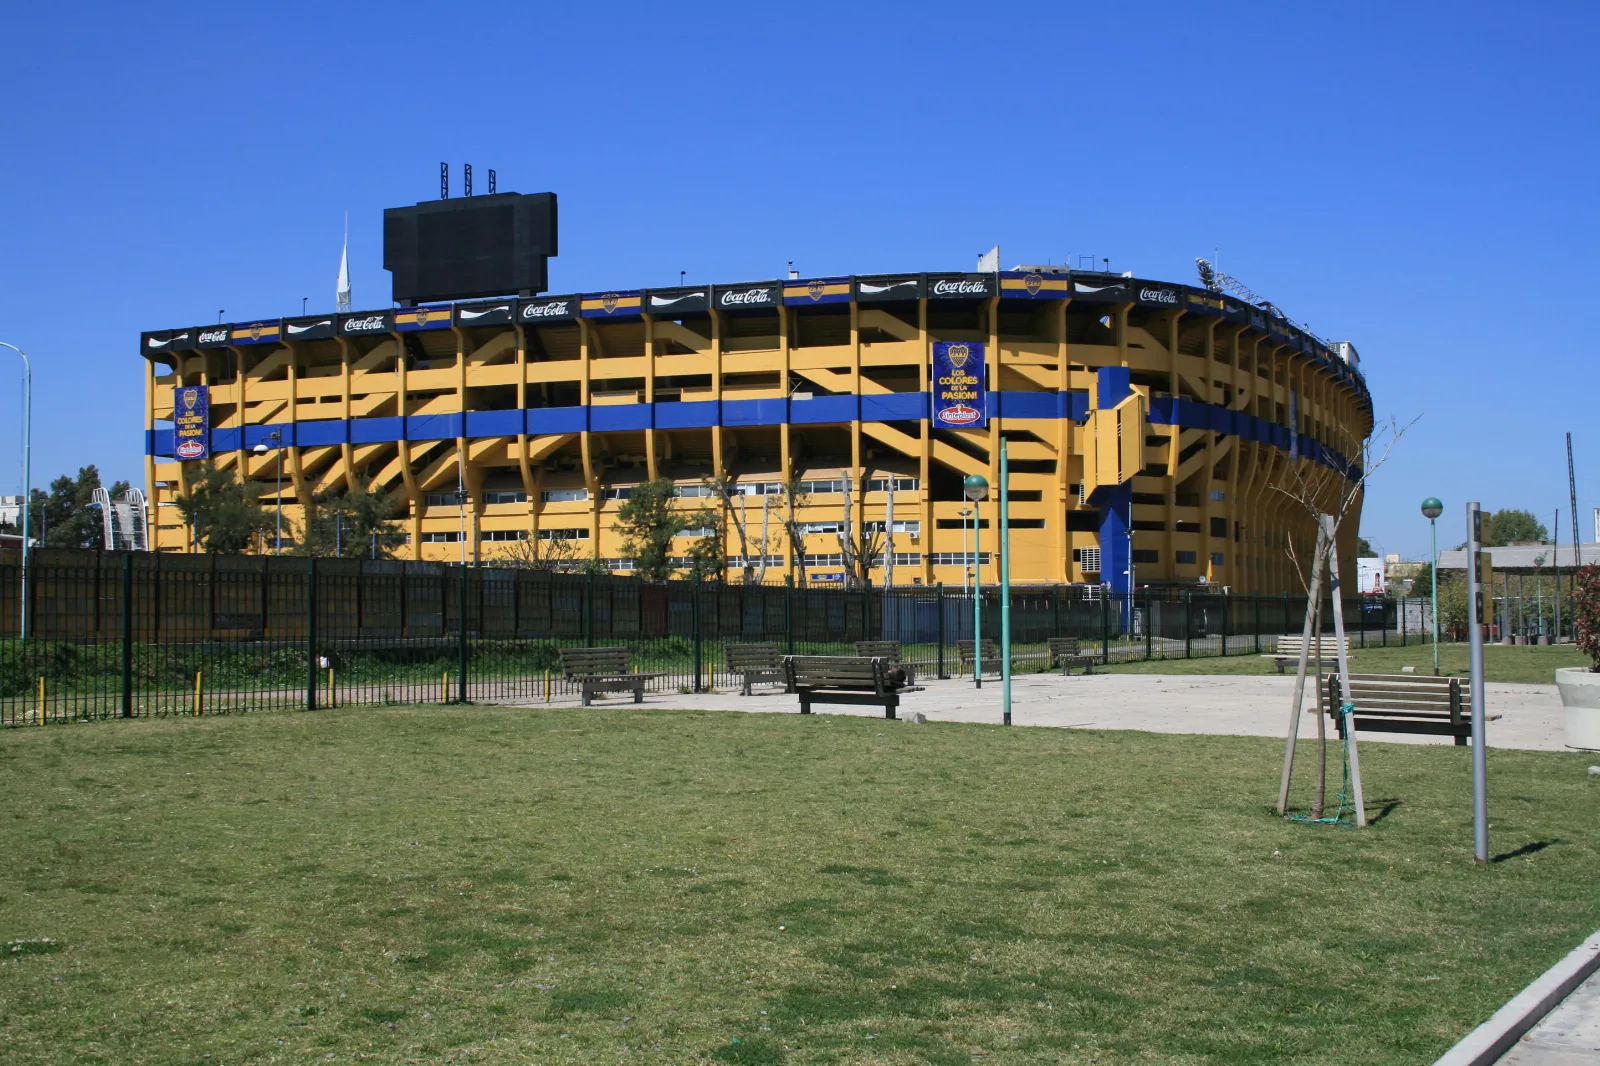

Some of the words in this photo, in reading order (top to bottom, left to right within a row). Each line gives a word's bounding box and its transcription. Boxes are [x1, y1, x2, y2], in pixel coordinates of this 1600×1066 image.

[933, 279, 986, 295] Coca-Cola
[1140, 286, 1177, 304] Coca-Cola
[721, 288, 771, 306] Coca-Cola
[523, 301, 567, 319] Coca-Cola
[344, 315, 385, 332] Coca-Cola
[199, 330, 227, 343] Coca-Cola
[939, 376, 978, 385] COLORES
[951, 369, 965, 377] LOS
